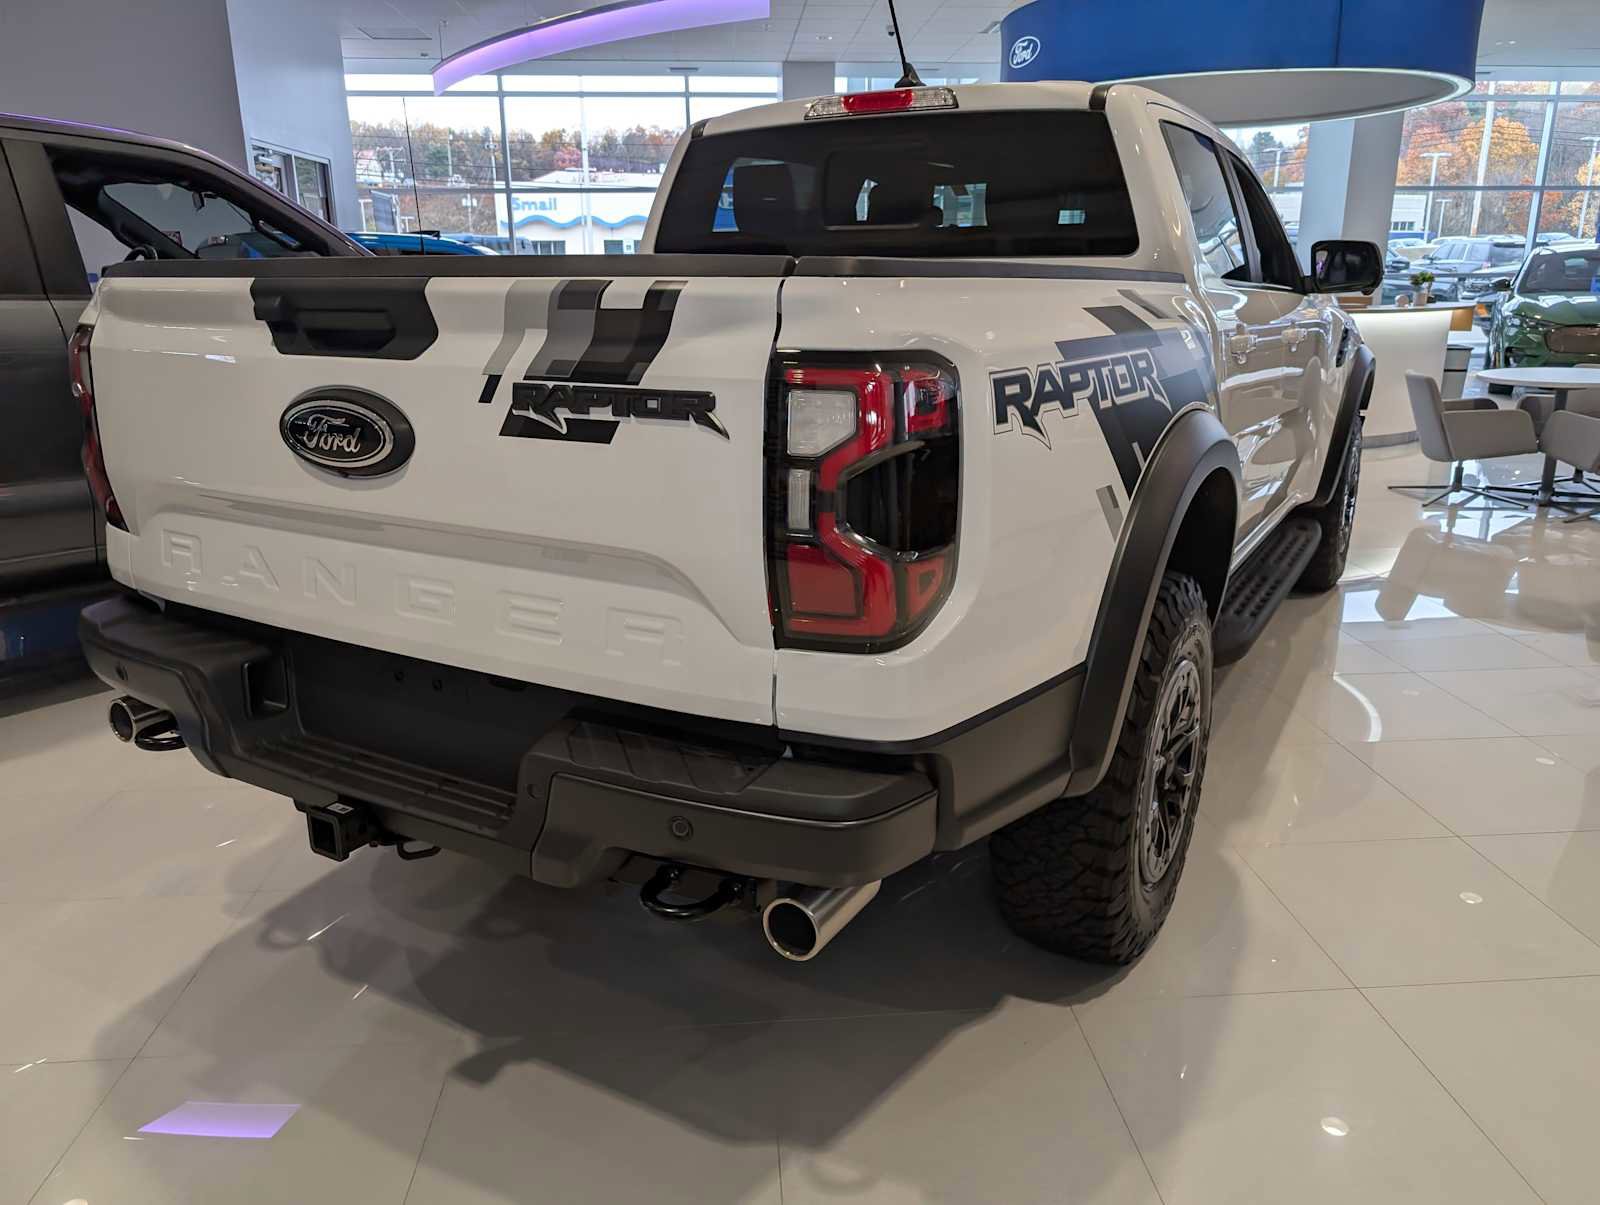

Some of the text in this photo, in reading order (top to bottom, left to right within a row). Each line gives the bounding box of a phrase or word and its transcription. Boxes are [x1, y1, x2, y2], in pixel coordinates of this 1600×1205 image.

[298, 413, 362, 453] Ford
[512, 382, 730, 441] RAPTOR
[988, 348, 1173, 451] RAPTOR
[161, 528, 684, 668] RANGER
